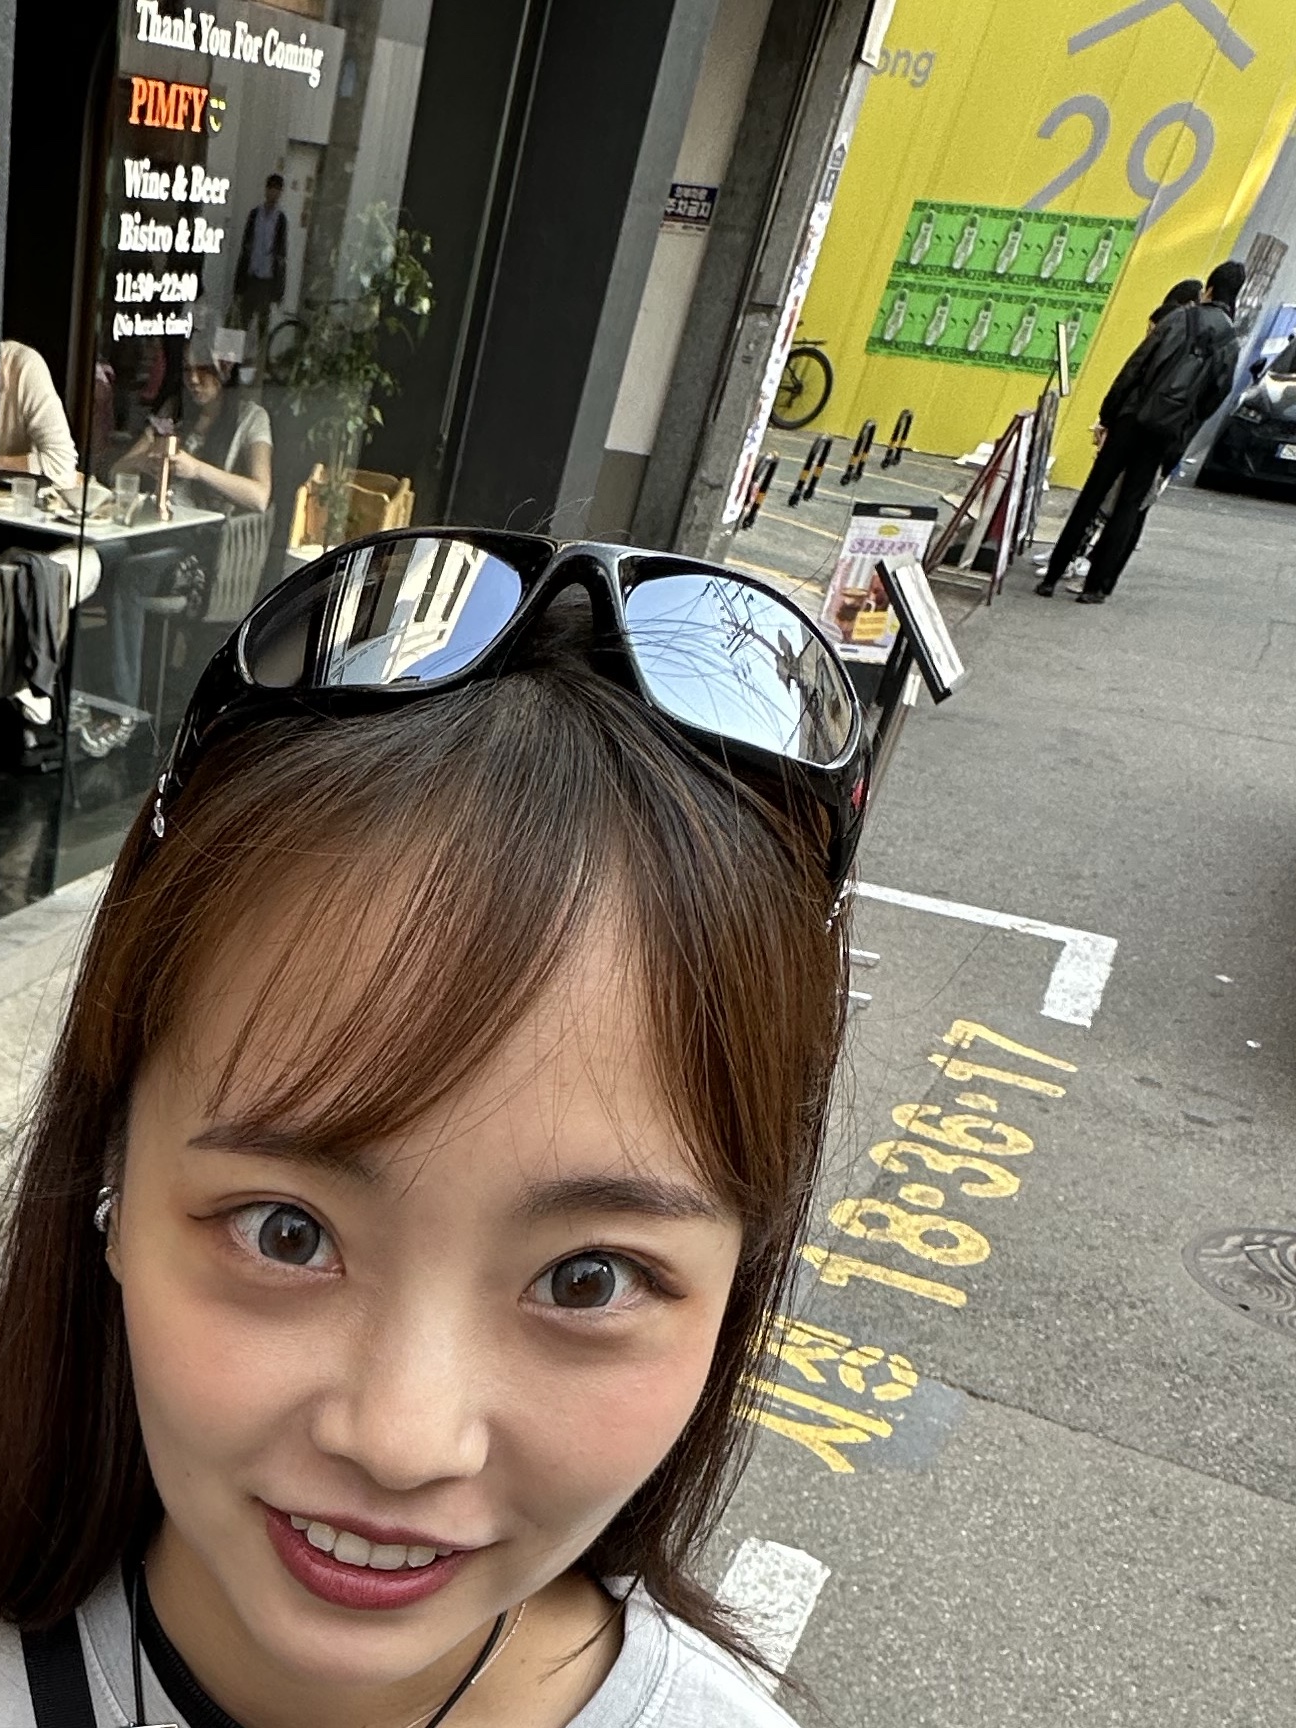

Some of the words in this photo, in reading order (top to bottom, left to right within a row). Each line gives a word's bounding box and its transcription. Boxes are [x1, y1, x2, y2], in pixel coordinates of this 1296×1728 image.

[136, 0, 197, 50] Thank
[198, 12, 231, 58] You
[232, 20, 263, 63] For
[263, 27, 324, 89] Coming
[128, 76, 209, 133] PIMFY
[124, 157, 171, 201] Wine
[171, 164, 189, 202] &
[189, 165, 230, 204] Beer
[1024, 94, 1216, 238] 29
[664, 198, 712, 218] 주차금지
[118, 211, 174, 253] Bistro
[174, 217, 191, 254] &
[191, 217, 225, 254] Bar
[113, 311, 134, 341] (No
